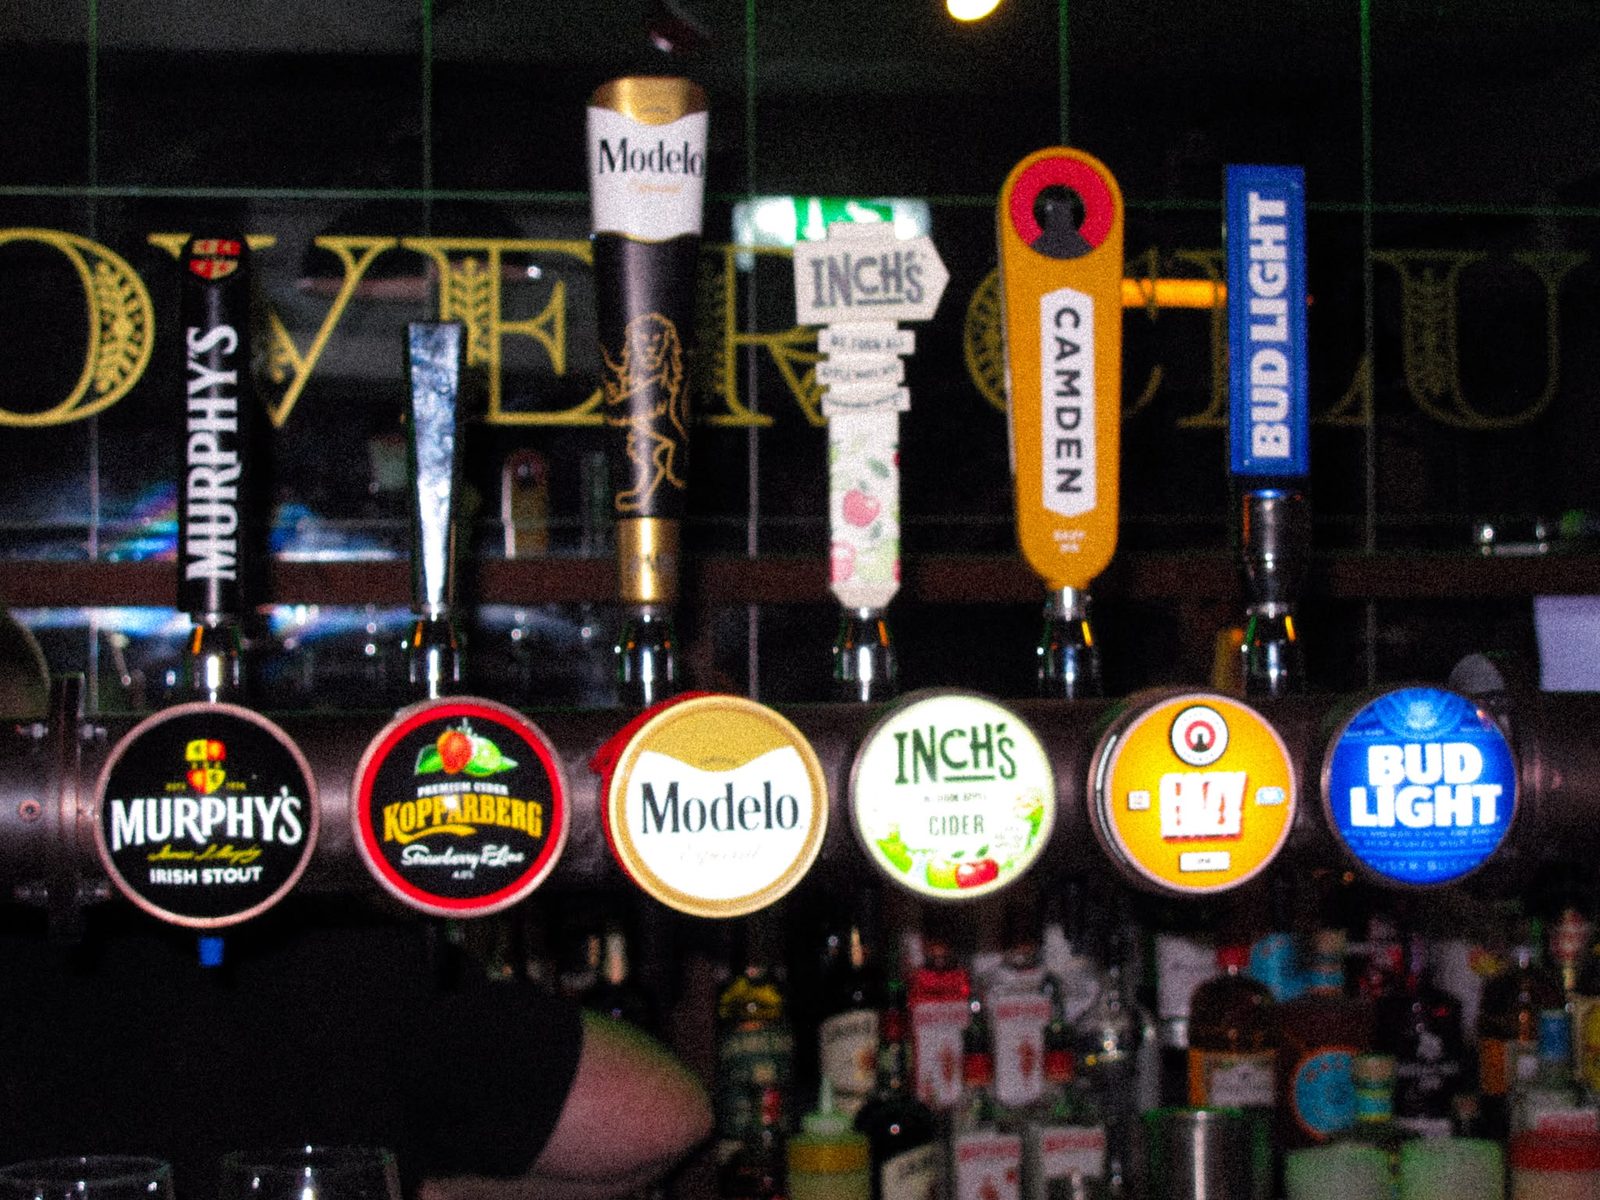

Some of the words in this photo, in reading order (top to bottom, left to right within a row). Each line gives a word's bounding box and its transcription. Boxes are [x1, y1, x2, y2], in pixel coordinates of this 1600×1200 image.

[598, 137, 706, 178] Modelo
[1247, 192, 1290, 344] LIGHT
[1053, 306, 1083, 494] CAMDEN
[1250, 360, 1292, 459] BUD
[186, 324, 239, 581] MURPHY'S
[893, 722, 1017, 785] INCH'S
[1368, 742, 1483, 786] BUD
[110, 785, 302, 851] MURPHY'S
[383, 793, 543, 845] KOPPARBERG
[641, 779, 799, 834] Modelo
[928, 814, 985, 836] CIDER
[1350, 784, 1503, 828] LIGHT
[150, 867, 197, 884] IRISH
[202, 865, 263, 884] STOUT
